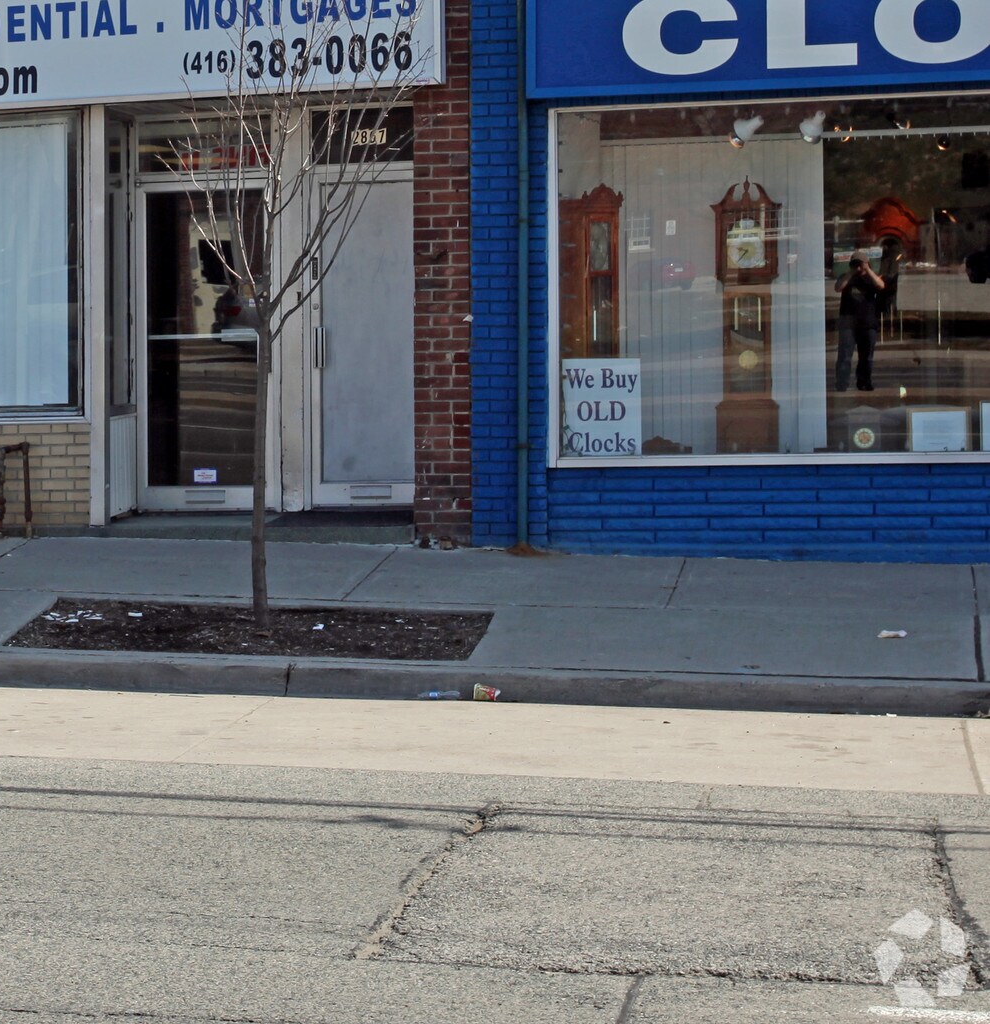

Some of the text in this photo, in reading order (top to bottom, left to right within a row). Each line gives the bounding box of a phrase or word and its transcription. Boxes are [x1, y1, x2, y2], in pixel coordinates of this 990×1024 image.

[183, 31, 412, 79] (416) 383-0066
[565, 368, 638, 394] We Buy
[577, 400, 626, 422] OLD
[568, 431, 637, 453] Clocks
